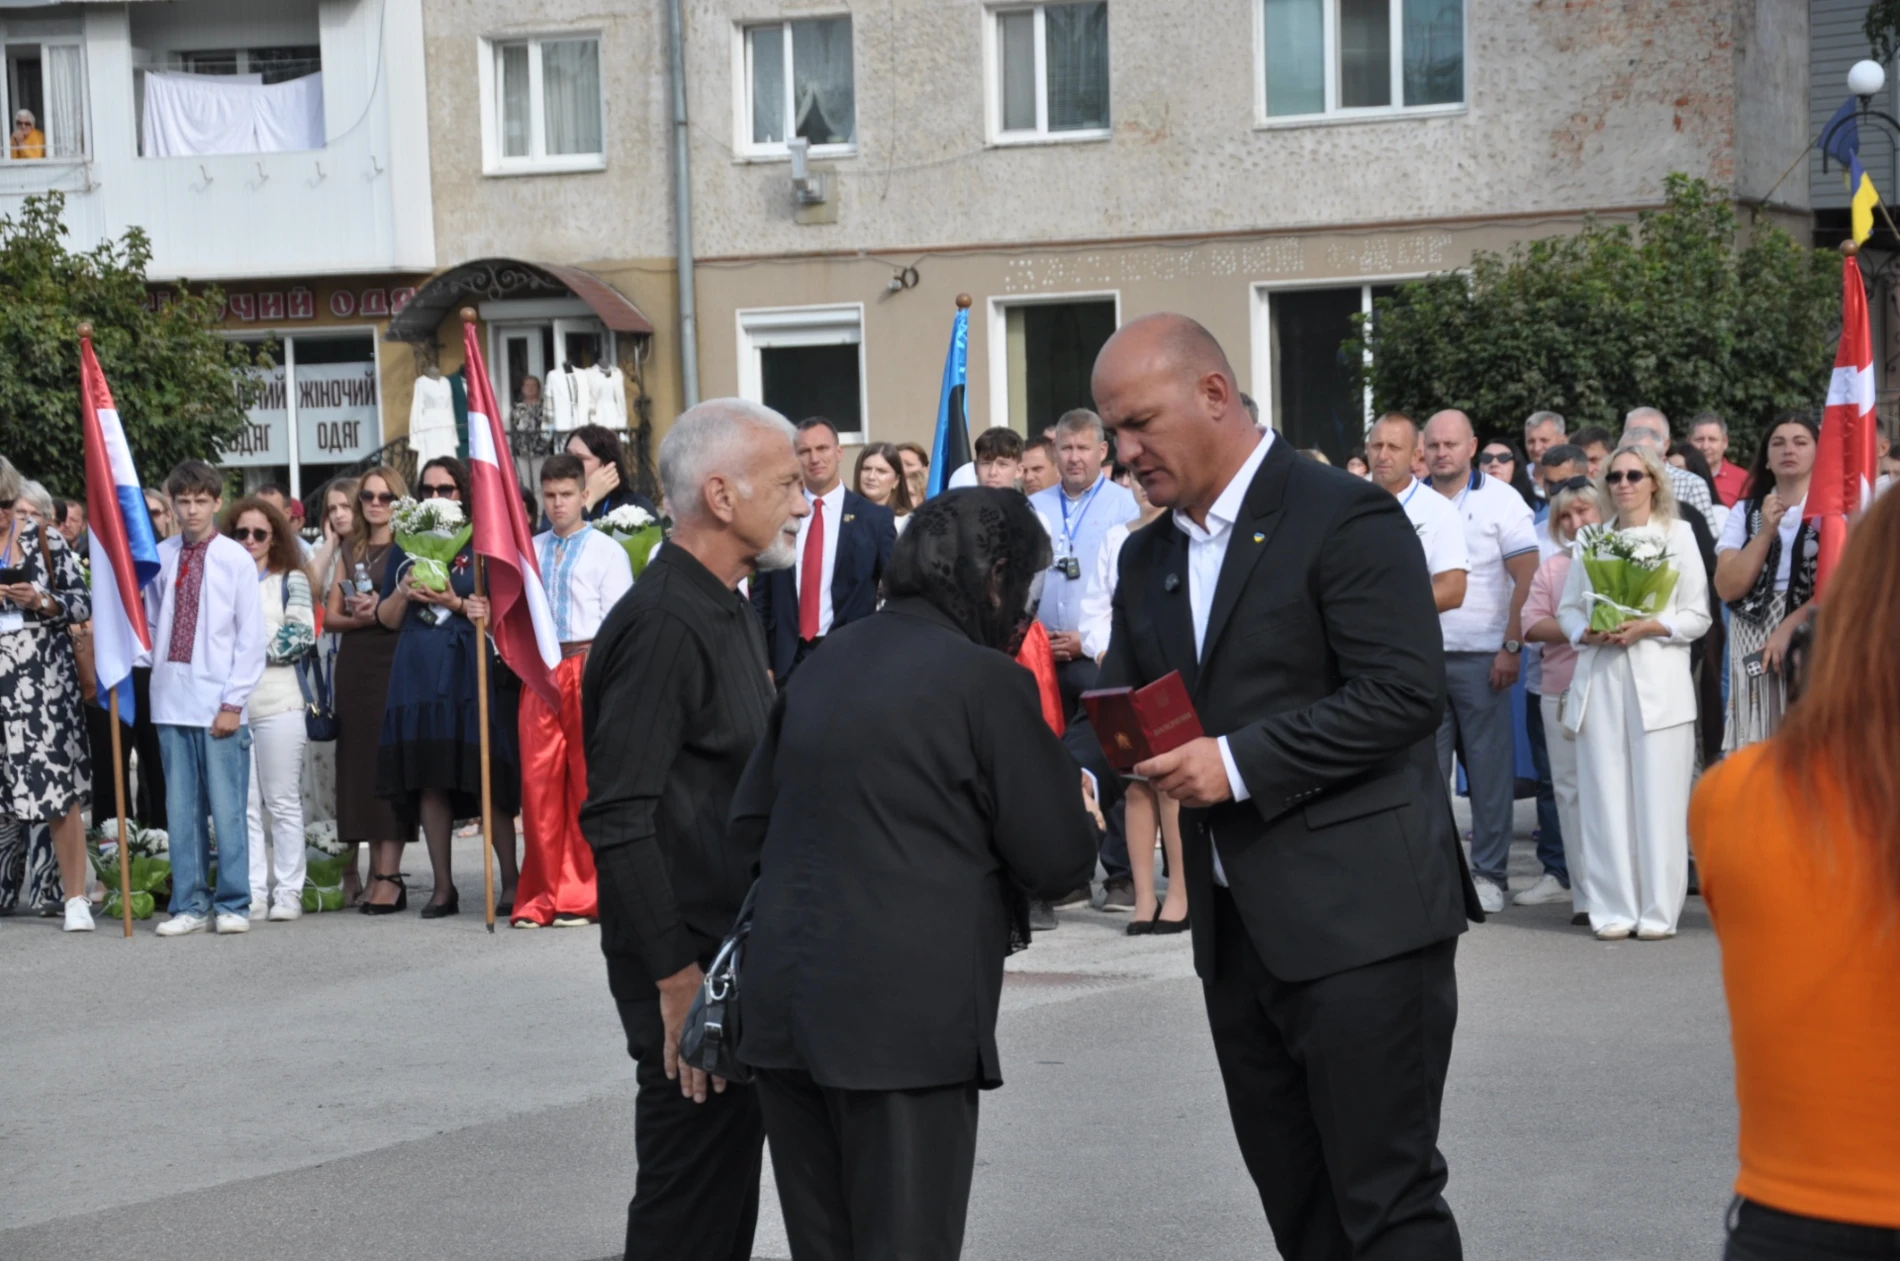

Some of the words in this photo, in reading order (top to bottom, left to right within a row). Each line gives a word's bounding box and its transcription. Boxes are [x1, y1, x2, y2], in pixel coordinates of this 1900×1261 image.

[330, 287, 416, 317] ОДЯ
[298, 369, 376, 409] ЖІНОЧИЙ
[317, 420, 361, 454] ОДЯГ
